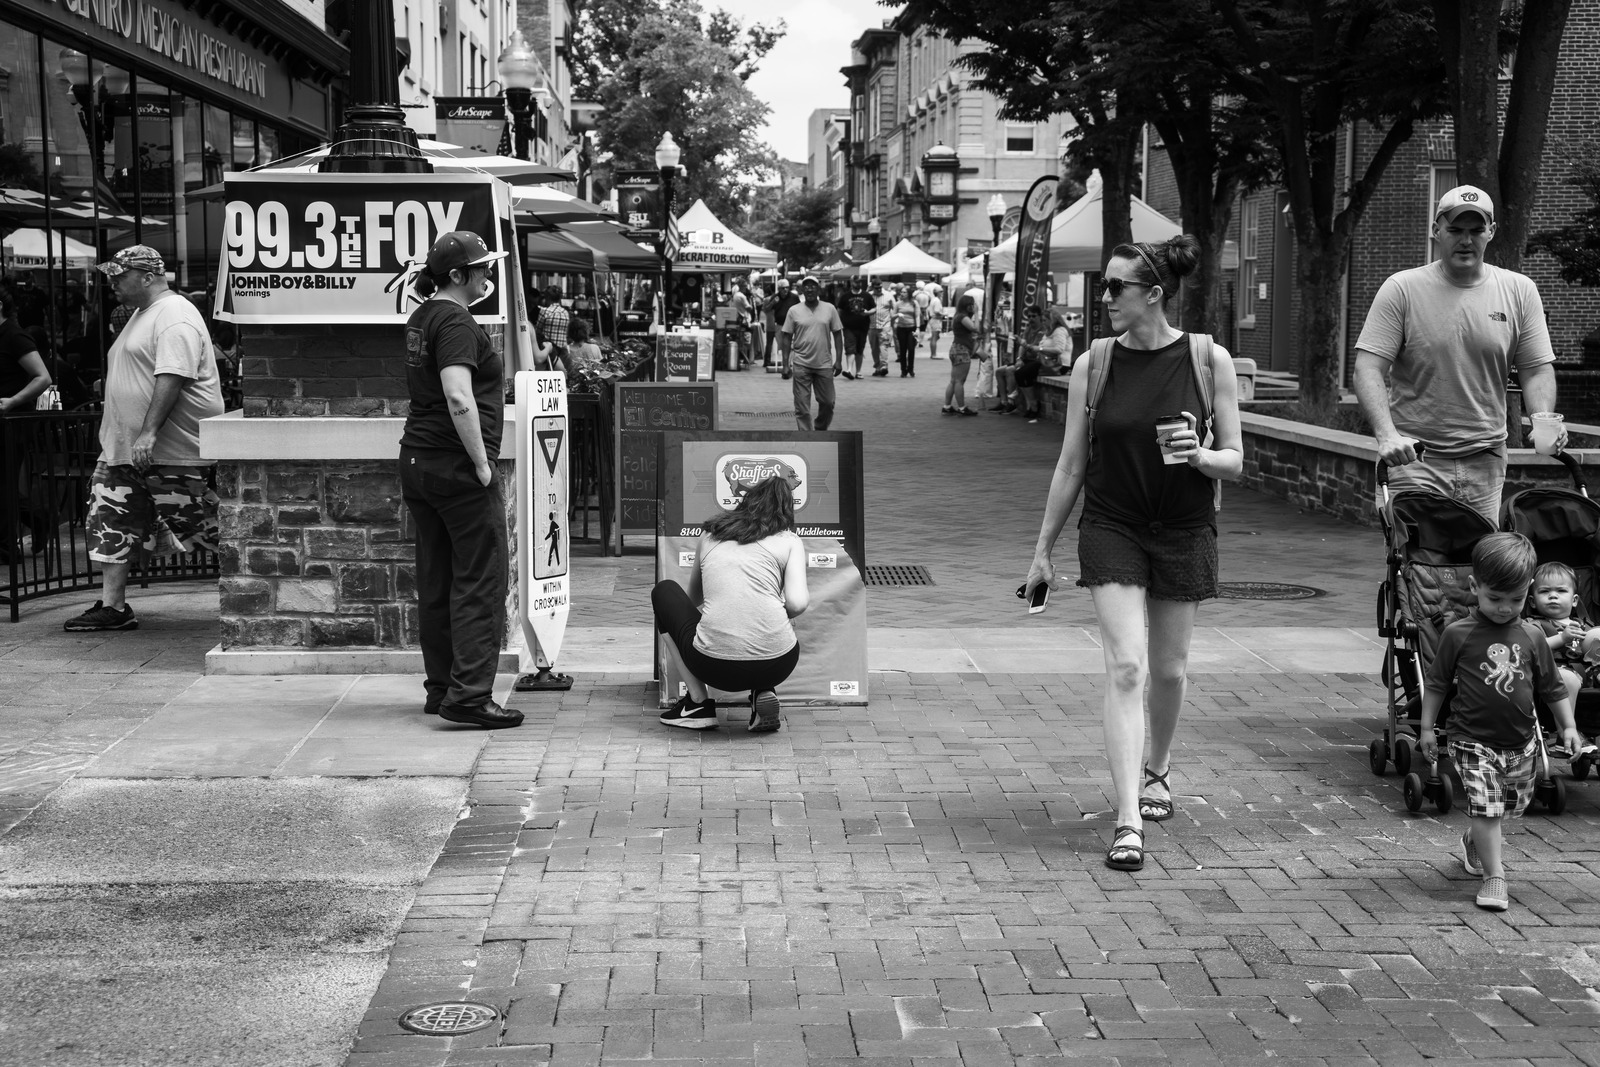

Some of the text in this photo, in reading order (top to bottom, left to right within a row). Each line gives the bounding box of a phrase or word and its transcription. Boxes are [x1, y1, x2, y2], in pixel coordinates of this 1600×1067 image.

[136, 0, 199, 69] MEXICAN
[200, 32, 267, 98] RESTAURANT
[448, 106, 493, 119] ArtScape
[225, 200, 465, 269] 99.3 THE FOX
[1020, 233, 1045, 337] HOCOLATE
[234, 290, 271, 299] Mornings
[662, 349, 694, 361] Escape
[663, 362, 691, 374] Room
[537, 379, 562, 394] STATE
[541, 397, 559, 412] LAW
[548, 493, 557, 505] TO
[679, 527, 844, 537] 8140 Middletown
[543, 581, 562, 594] WITHIN
[534, 594, 567, 611] CROSSWALK
